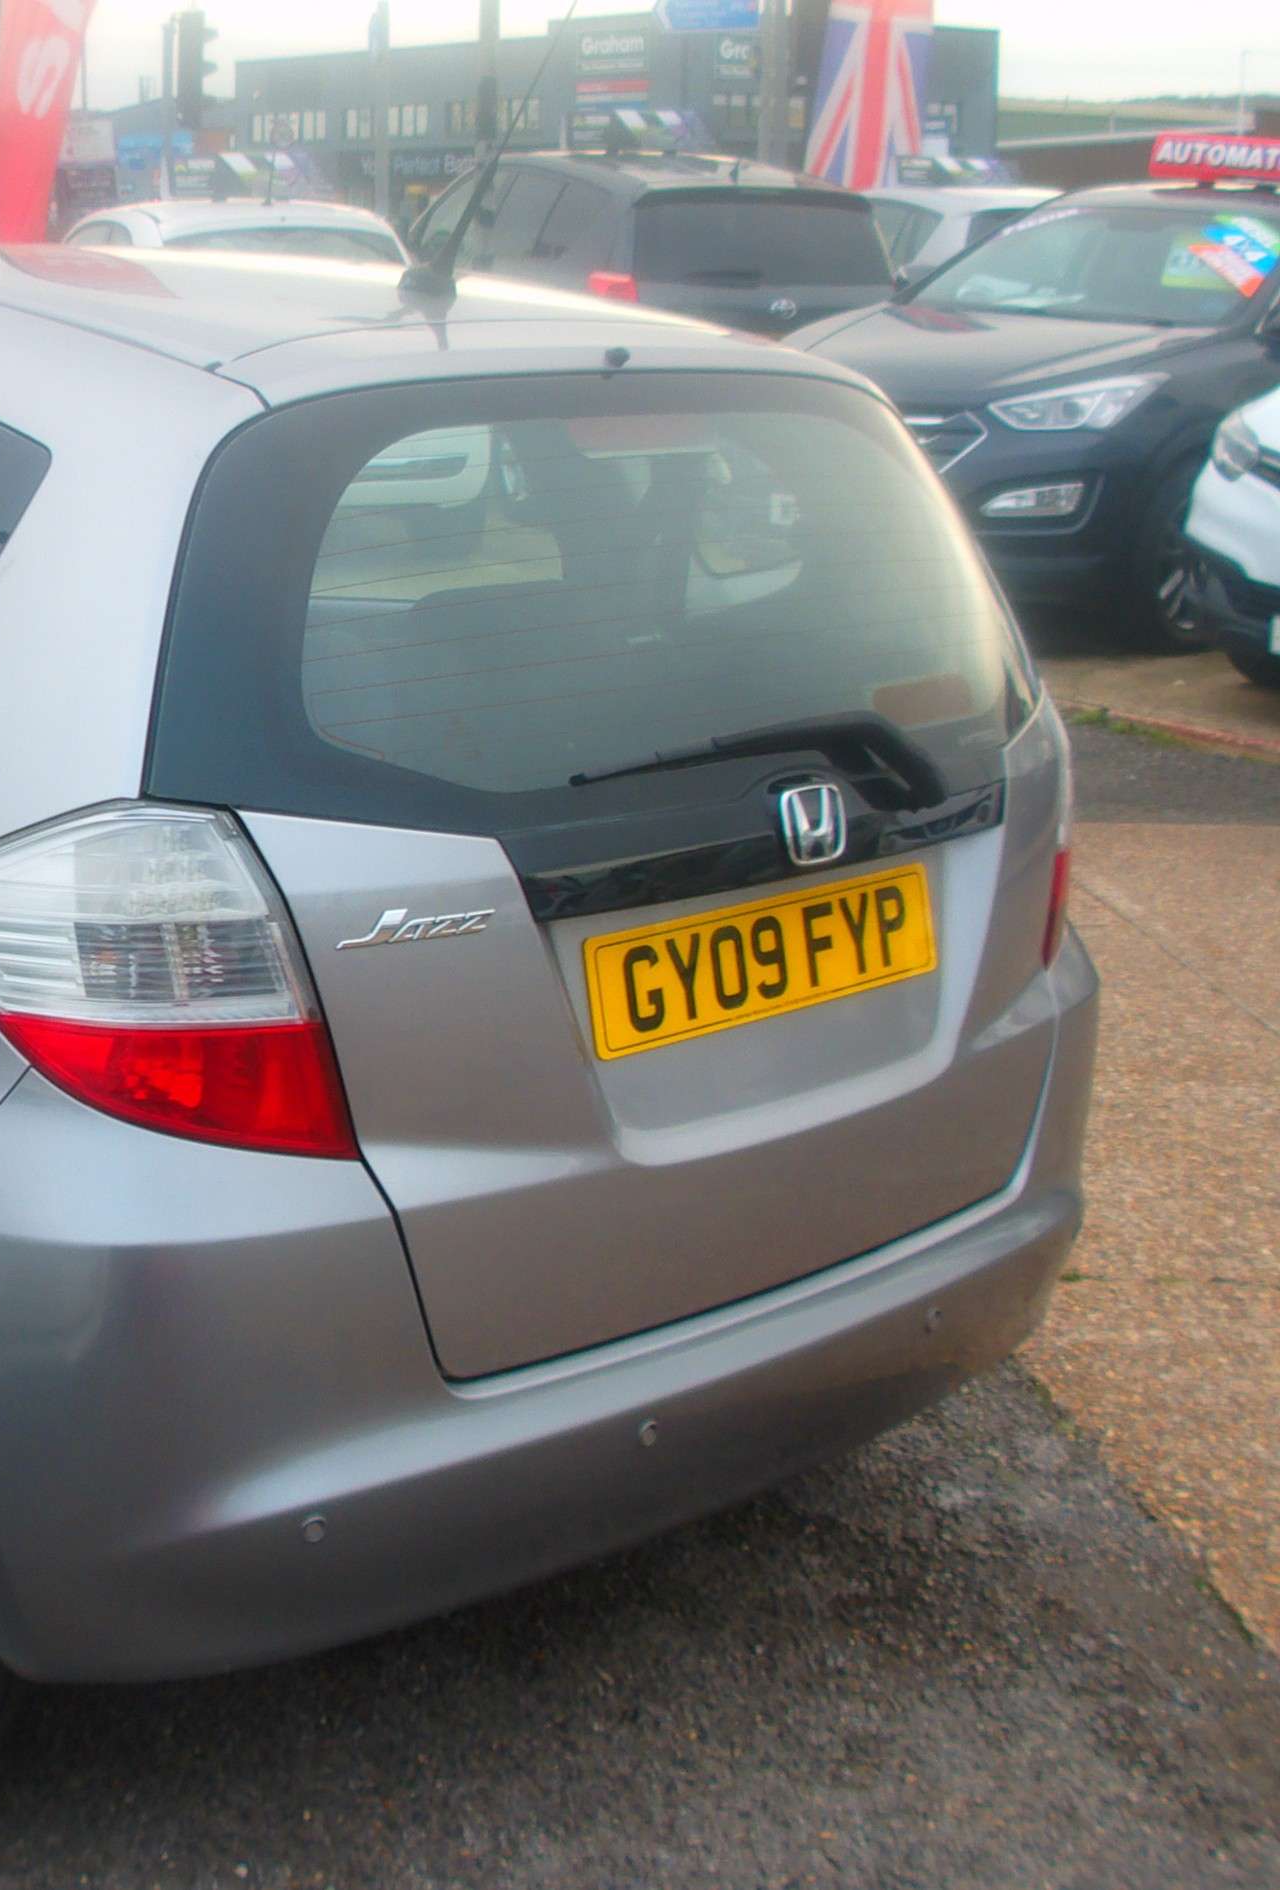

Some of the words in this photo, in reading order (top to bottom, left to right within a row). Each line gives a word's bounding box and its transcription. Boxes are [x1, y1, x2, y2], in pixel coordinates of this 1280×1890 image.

[581, 34, 645, 55] Graham
[622, 914, 788, 1034] GY09
[801, 884, 906, 988] FYP
